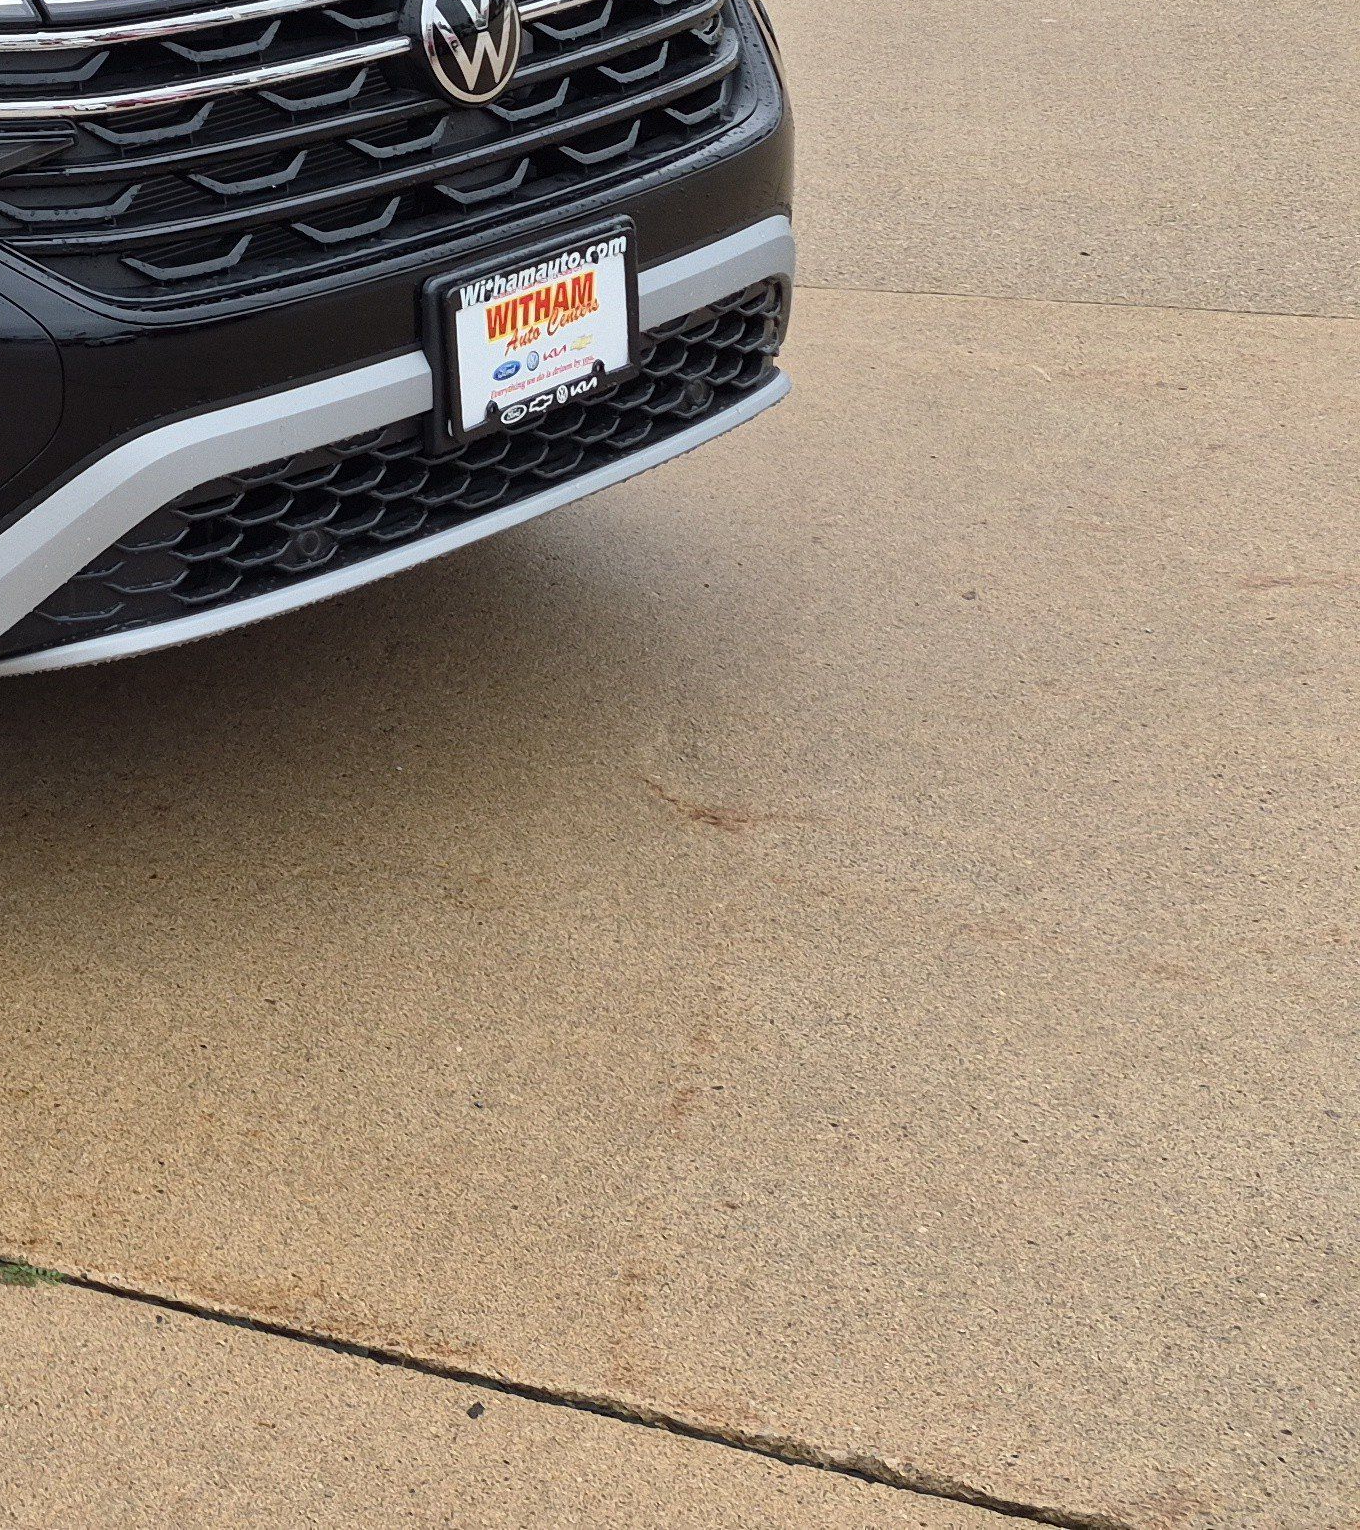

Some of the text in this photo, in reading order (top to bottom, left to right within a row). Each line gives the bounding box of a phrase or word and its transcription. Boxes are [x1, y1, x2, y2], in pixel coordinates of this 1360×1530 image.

[459, 235, 628, 309] Withamauto.com
[485, 271, 597, 341] WITHAM
[504, 325, 542, 357] Auto
